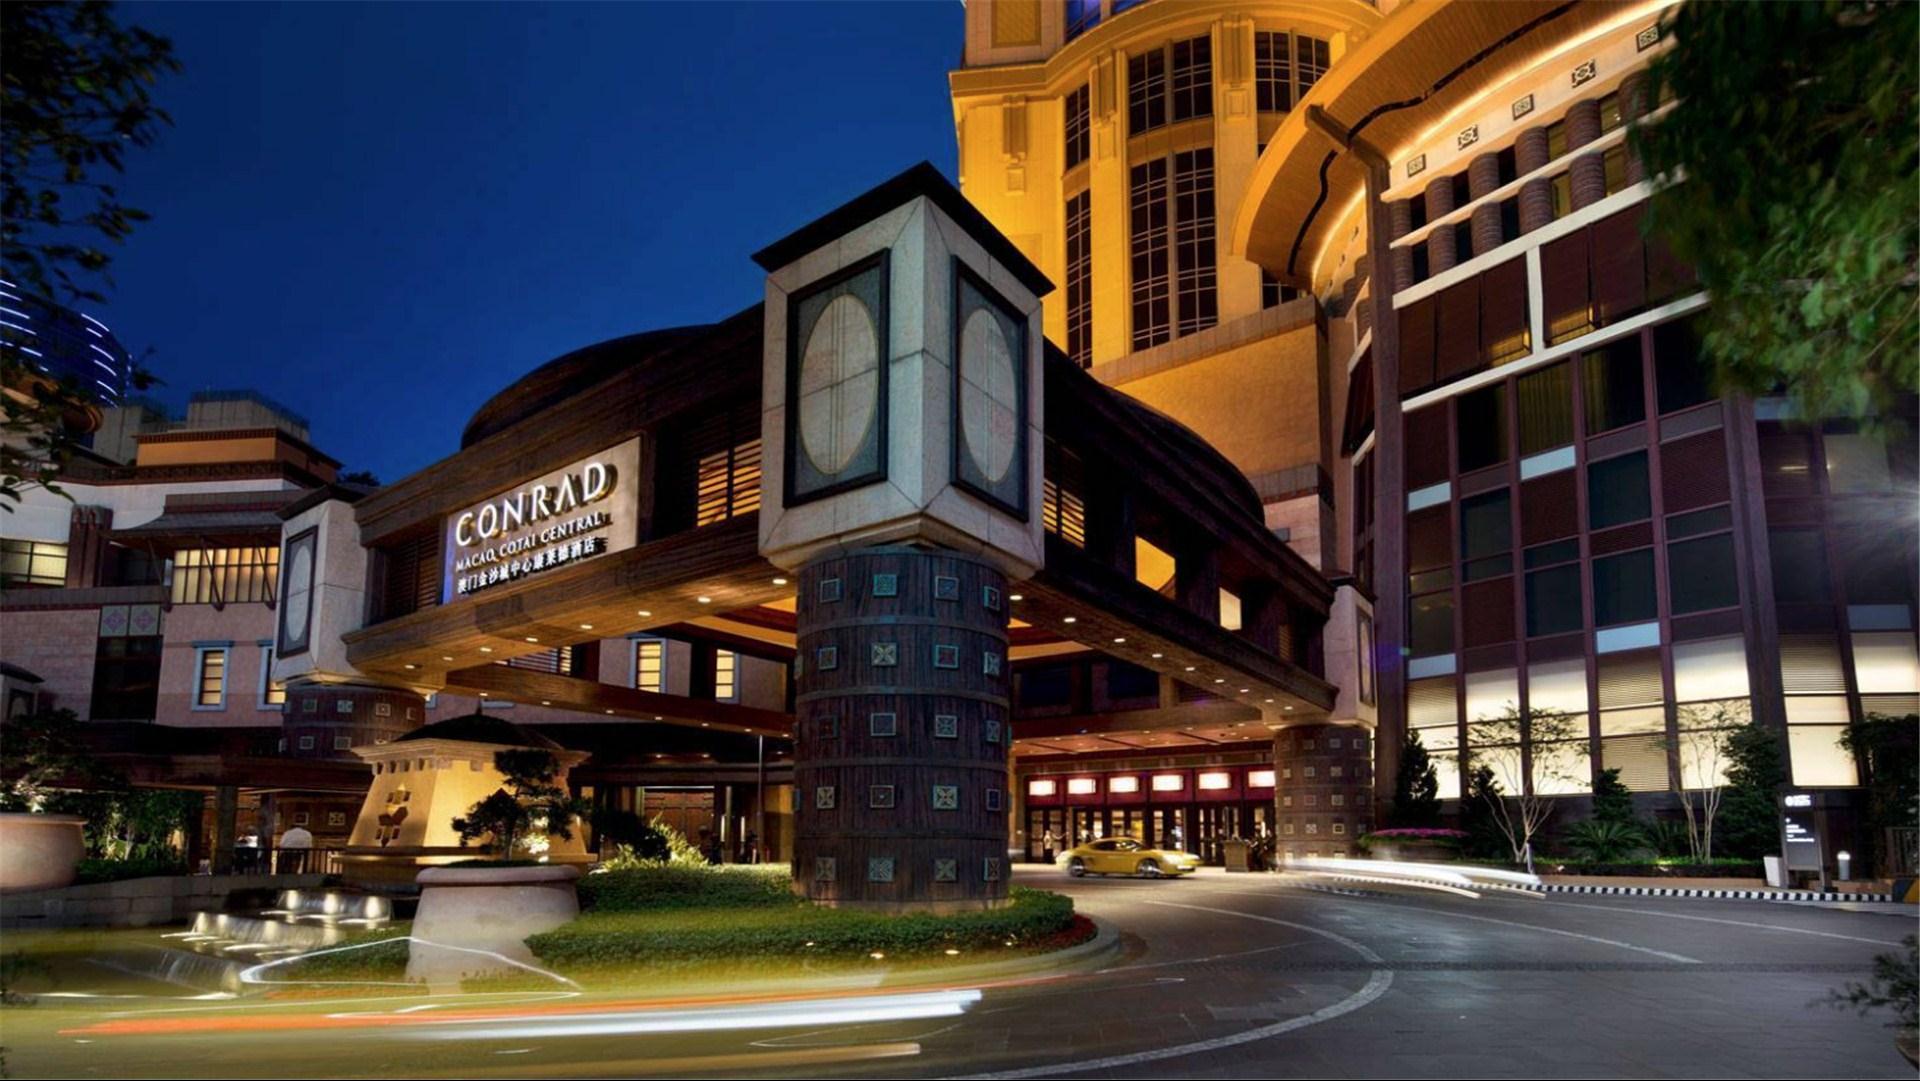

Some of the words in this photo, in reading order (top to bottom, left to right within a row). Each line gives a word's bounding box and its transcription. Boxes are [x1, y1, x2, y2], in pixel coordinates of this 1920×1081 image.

[455, 461, 606, 546] CONRAD
[499, 534, 536, 558] COTAI
[540, 511, 601, 543] CENTRAL
